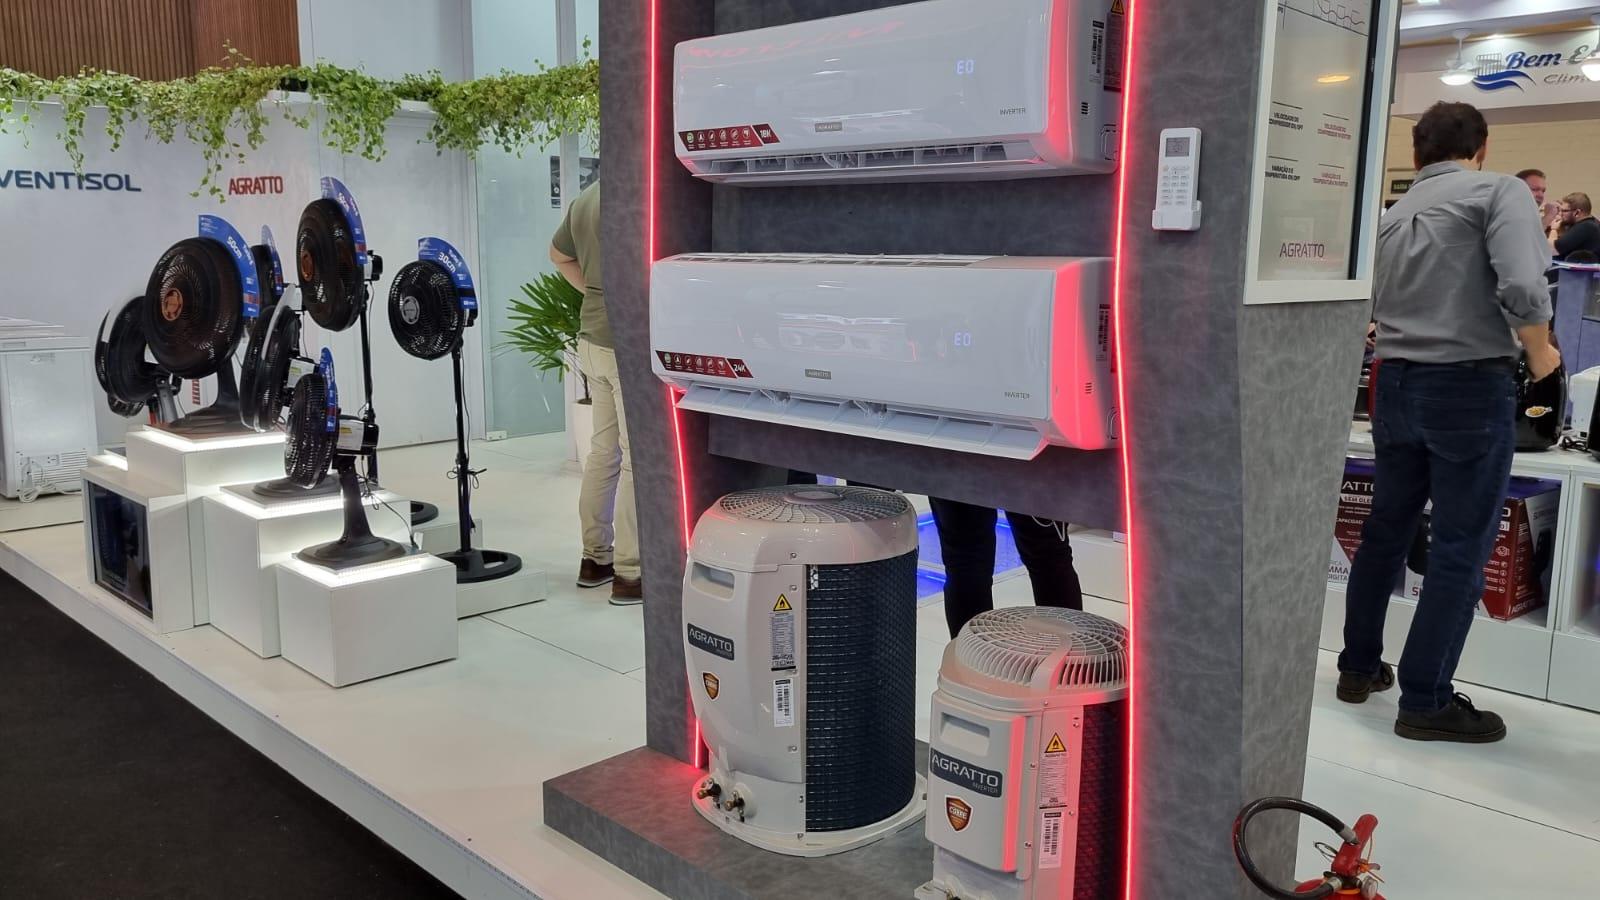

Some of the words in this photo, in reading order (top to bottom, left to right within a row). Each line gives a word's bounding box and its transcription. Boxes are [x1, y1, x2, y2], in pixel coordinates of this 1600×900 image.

[1506, 51, 1562, 70] Bem
[1000, 107, 1026, 116] INVERTER
[760, 128, 771, 139] 18K
[0, 170, 142, 192] VENTISOL
[229, 176, 284, 196] AGRATTO
[227, 236, 242, 258] 50cm
[1280, 243, 1325, 258] AGRATTO
[438, 252, 456, 273] 30cm
[733, 363, 746, 372] 24K
[1327, 573, 1349, 581] DIGITA
[689, 627, 732, 652] AGRATTO
[931, 754, 999, 787] AGRATTO
